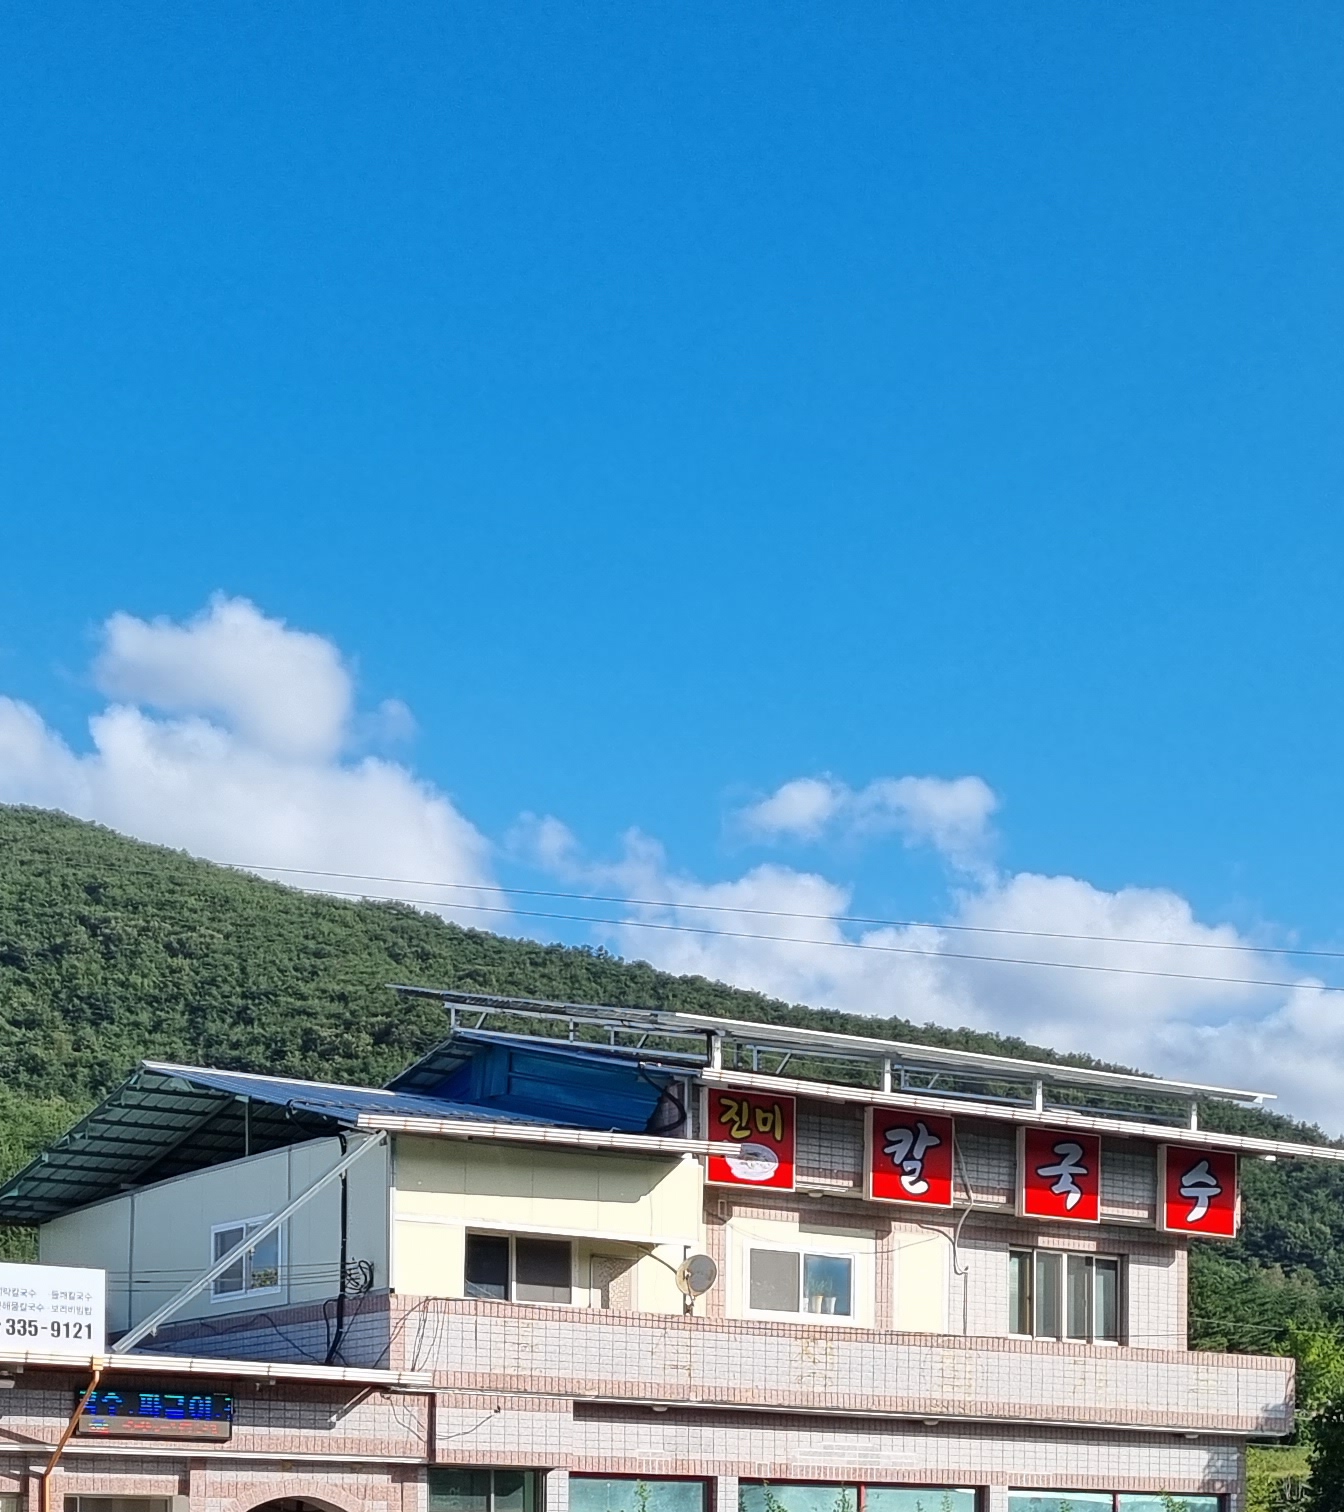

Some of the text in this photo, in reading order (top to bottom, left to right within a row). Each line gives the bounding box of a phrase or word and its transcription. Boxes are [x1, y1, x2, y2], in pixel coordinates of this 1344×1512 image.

[719, 1097, 1222, 1223] 진미 칼 국 수
[5, 1318, 92, 1340] 335-9121
